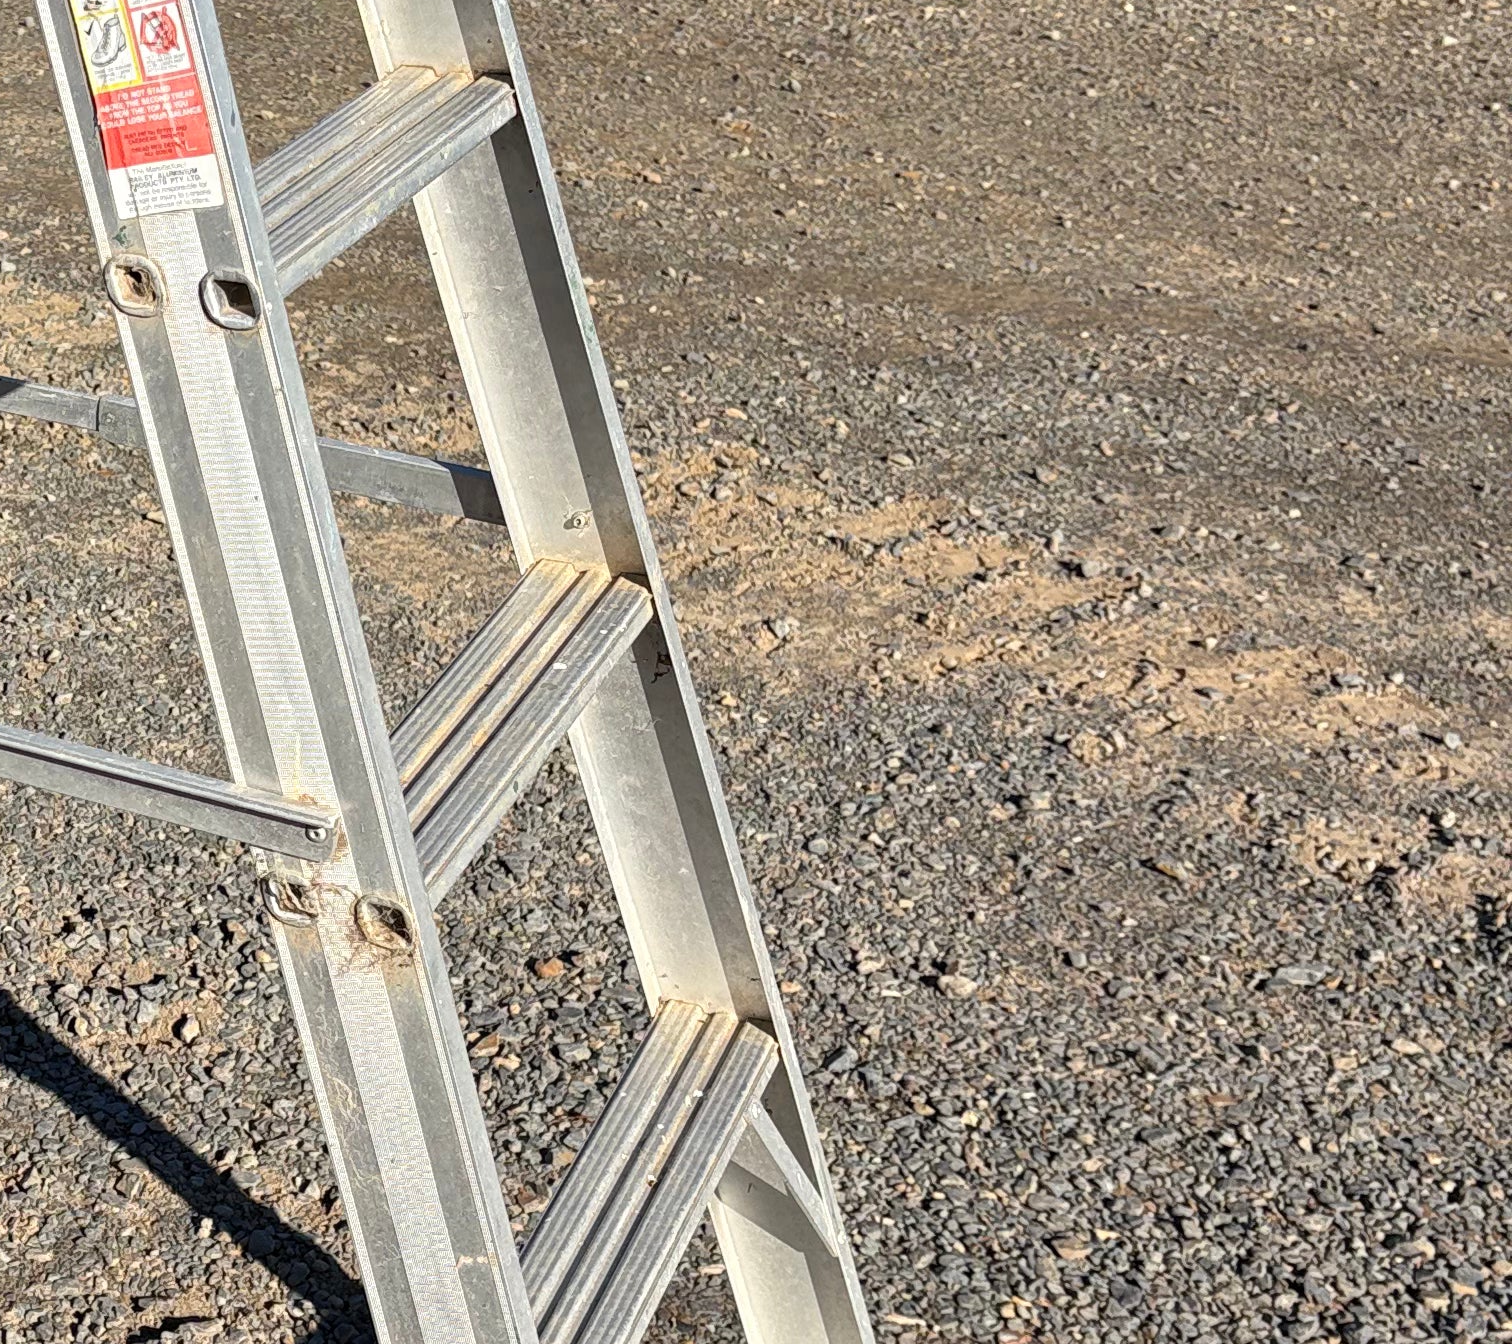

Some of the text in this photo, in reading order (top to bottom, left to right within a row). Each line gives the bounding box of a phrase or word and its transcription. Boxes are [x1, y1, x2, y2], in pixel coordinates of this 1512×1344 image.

[146, 84, 171, 96] STAND
[126, 99, 140, 108] THE
[141, 94, 171, 106] SECOND
[171, 89, 195, 100] TREAD
[130, 106, 145, 116] THE
[146, 103, 161, 113] TOP
[173, 99, 189, 109] YOU
[147, 111, 168, 122] YOUR
[129, 175, 153, 184] BAILEY
